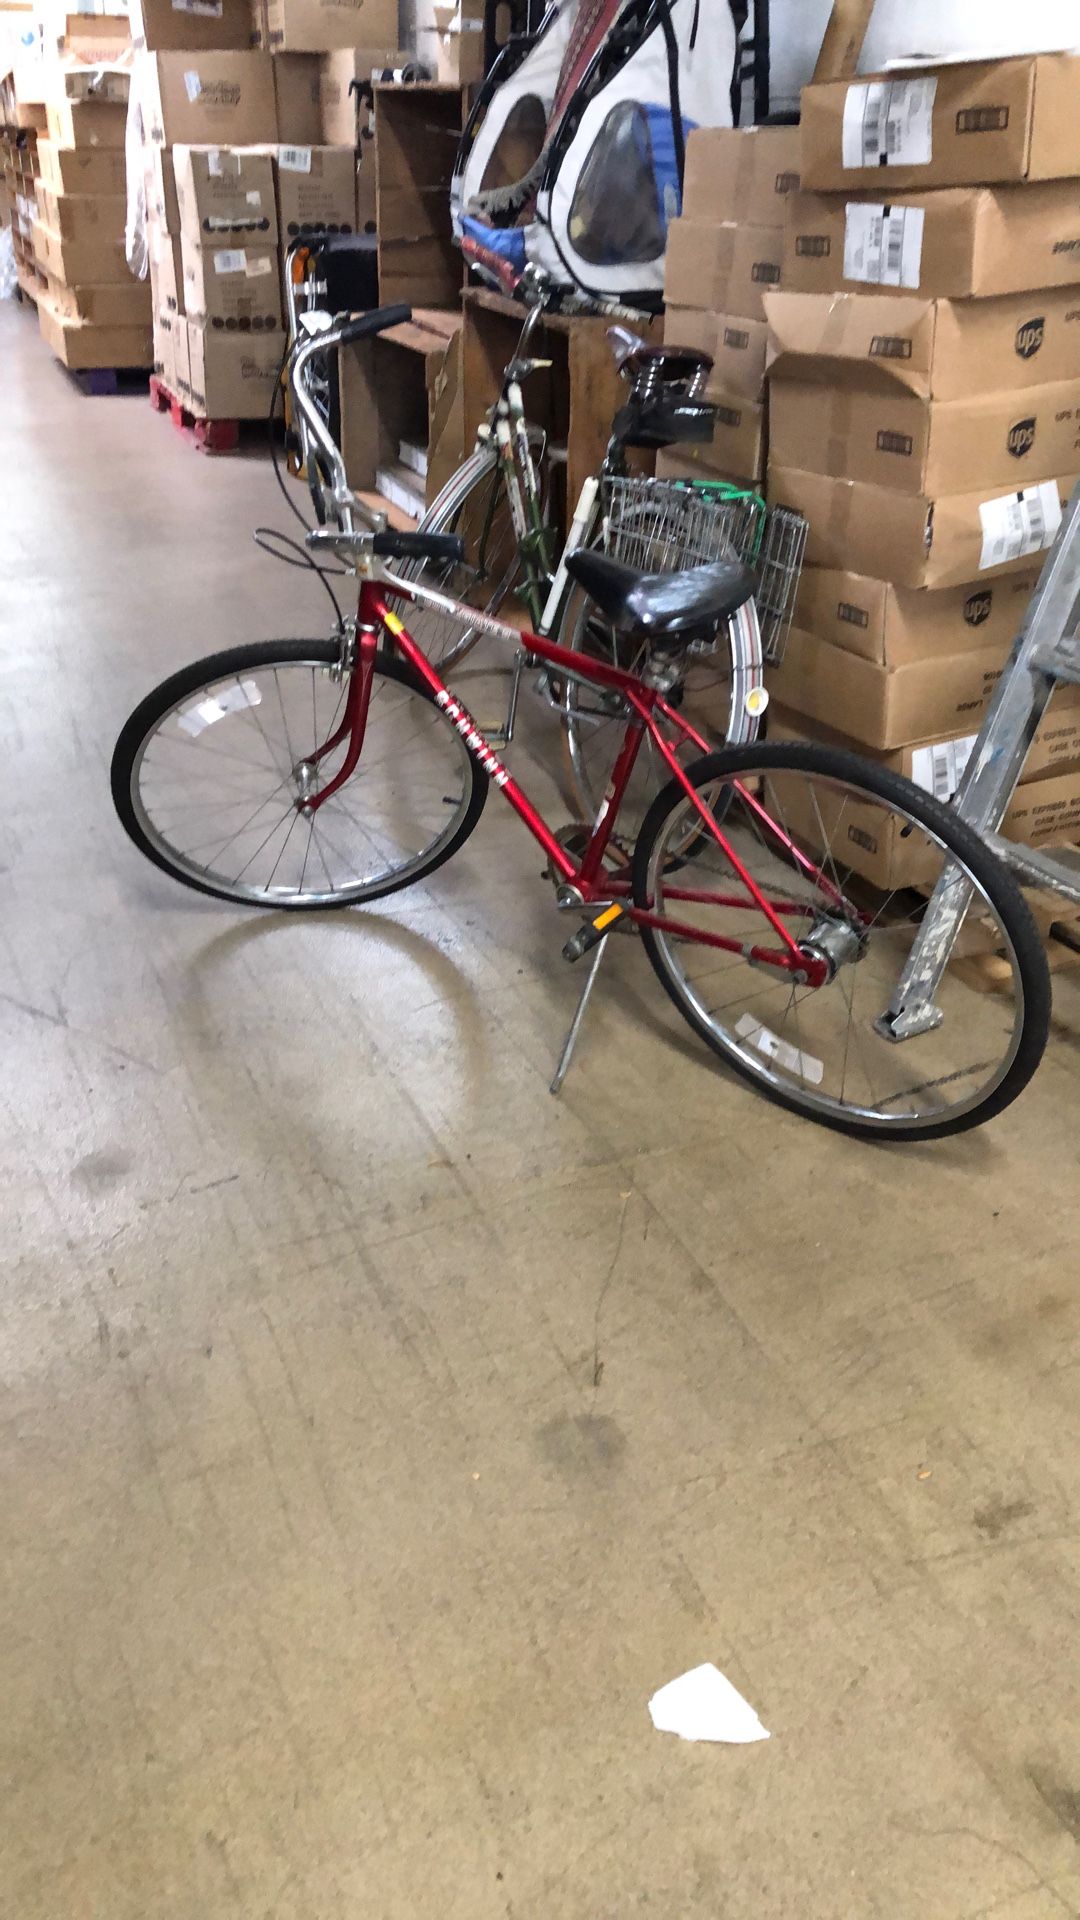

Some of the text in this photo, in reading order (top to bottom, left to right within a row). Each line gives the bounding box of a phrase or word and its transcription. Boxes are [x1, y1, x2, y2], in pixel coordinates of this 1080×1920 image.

[1016, 325, 1044, 355] ups
[1008, 426, 1035, 453] ups
[964, 597, 992, 622] ups
